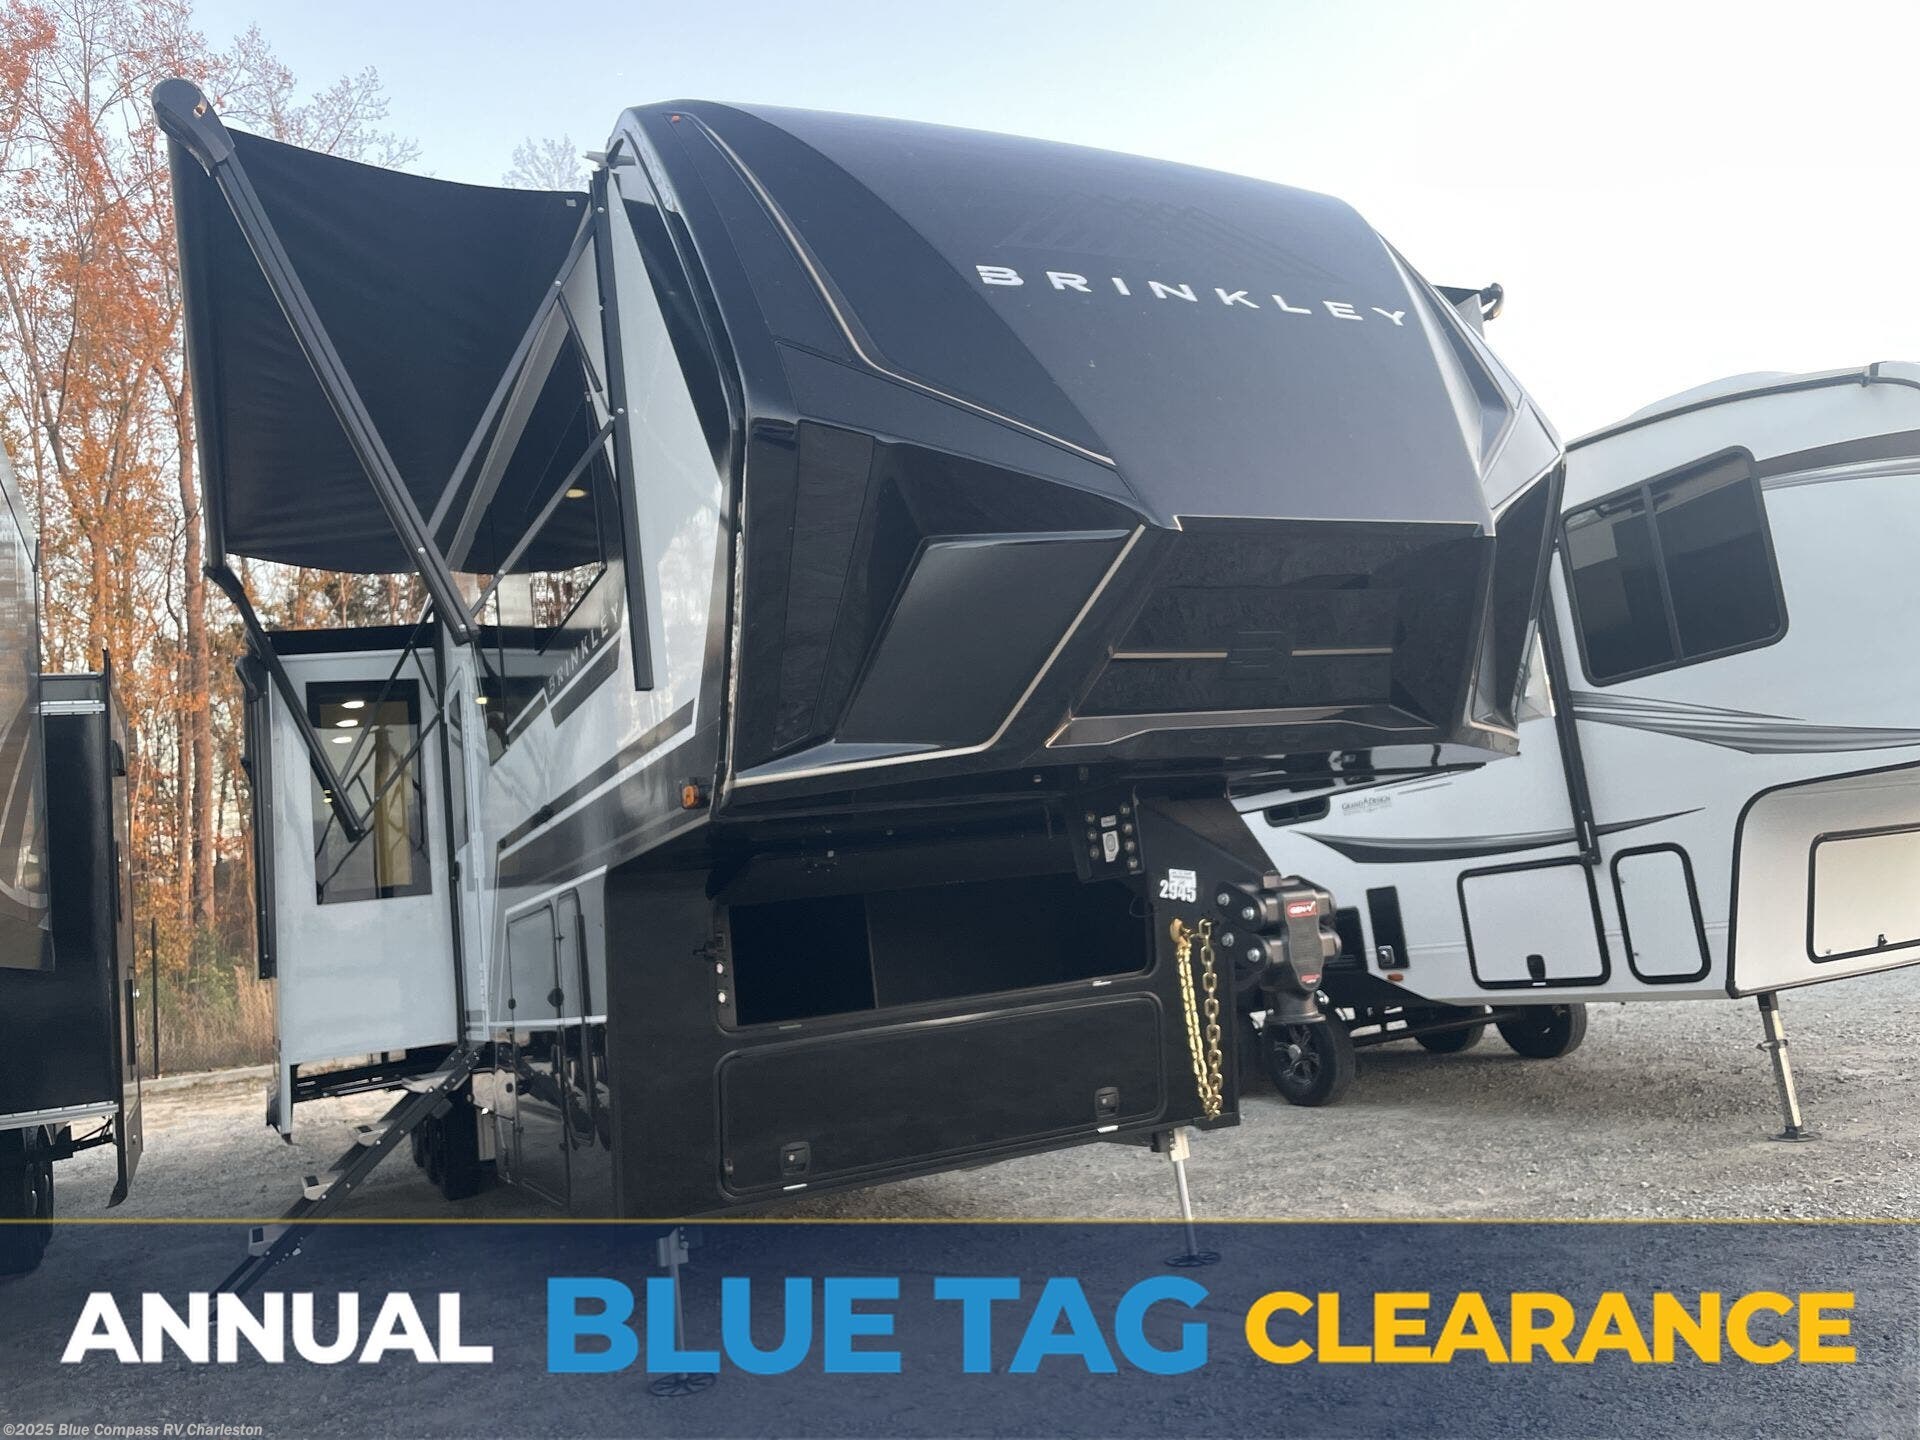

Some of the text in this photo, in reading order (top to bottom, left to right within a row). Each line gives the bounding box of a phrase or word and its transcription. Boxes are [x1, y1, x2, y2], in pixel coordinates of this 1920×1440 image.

[975, 264, 1406, 327] BRINKLEY
[548, 604, 619, 696] BRINKLEY
[1159, 879, 1197, 903] 2945
